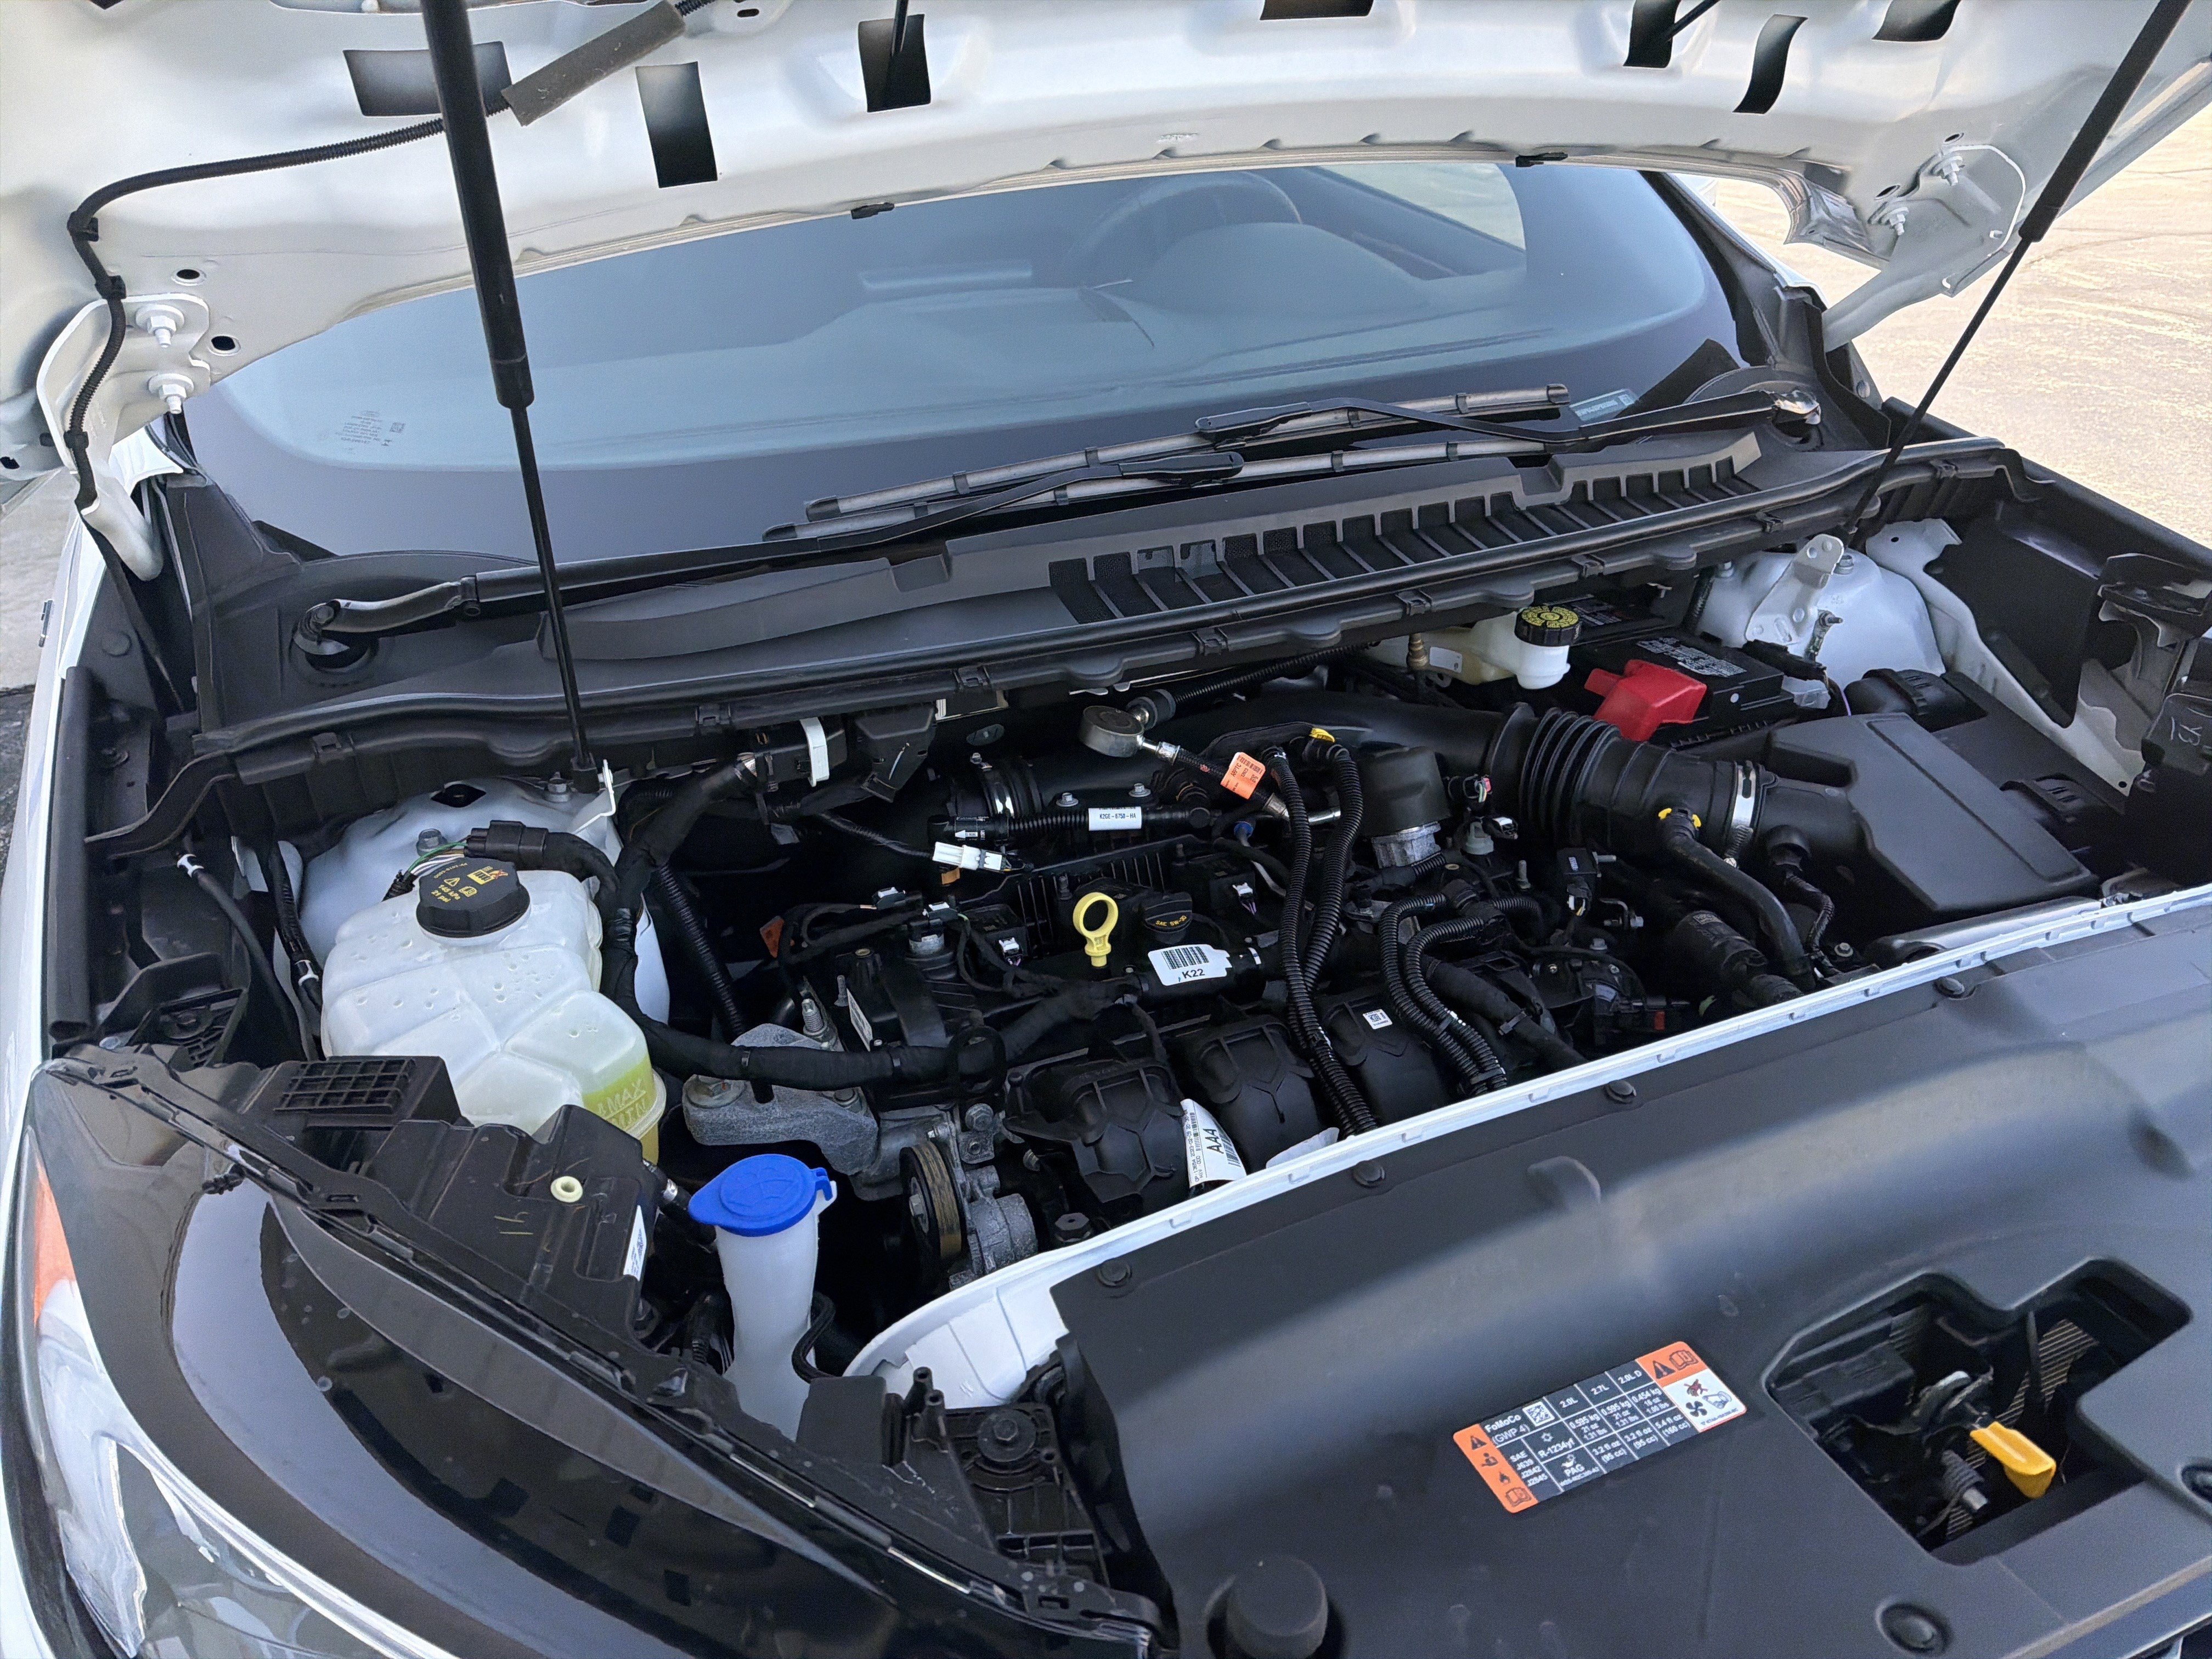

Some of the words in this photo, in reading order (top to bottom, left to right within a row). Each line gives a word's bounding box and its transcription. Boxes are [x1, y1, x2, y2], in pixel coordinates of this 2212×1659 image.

[1170, 915, 1187, 926] 5W-30
[1182, 968, 1205, 979] K22
[606, 1079, 646, 1113] MAX
[1203, 1128, 1224, 1154] AAA
[1618, 1373, 1635, 1384] 2.0L
[1590, 1384, 1610, 1395] 2.7L
[1632, 1390, 1651, 1403] 0.454
[1651, 1387, 1662, 1397] kg
[1559, 1397, 1579, 1408] 2.0L
[1620, 1400, 1632, 1409] kg
[1659, 1401, 1669, 1410] lbs
[1484, 1414, 1521, 1432] FoMoCo
[1589, 1413, 1601, 1422] kg
[1629, 1414, 1639, 1422] lbs
[1655, 1420, 1666, 1429] 5.4
[1677, 1421, 1691, 1431] cc)
[1492, 1428, 1518, 1445] (GWP
[1519, 1424, 1531, 1434] 4)
[1624, 1433, 1636, 1442] 3.2
[1646, 1435, 1658, 1444] cc)
[1538, 1437, 1576, 1458] R-1234yf
[1592, 1446, 1605, 1455] 3.2
[1614, 1448, 1627, 1457] cc)
[1510, 1451, 1528, 1463] SAE
[1516, 1459, 1534, 1470] J639
[1564, 1464, 1585, 1477] PAG
